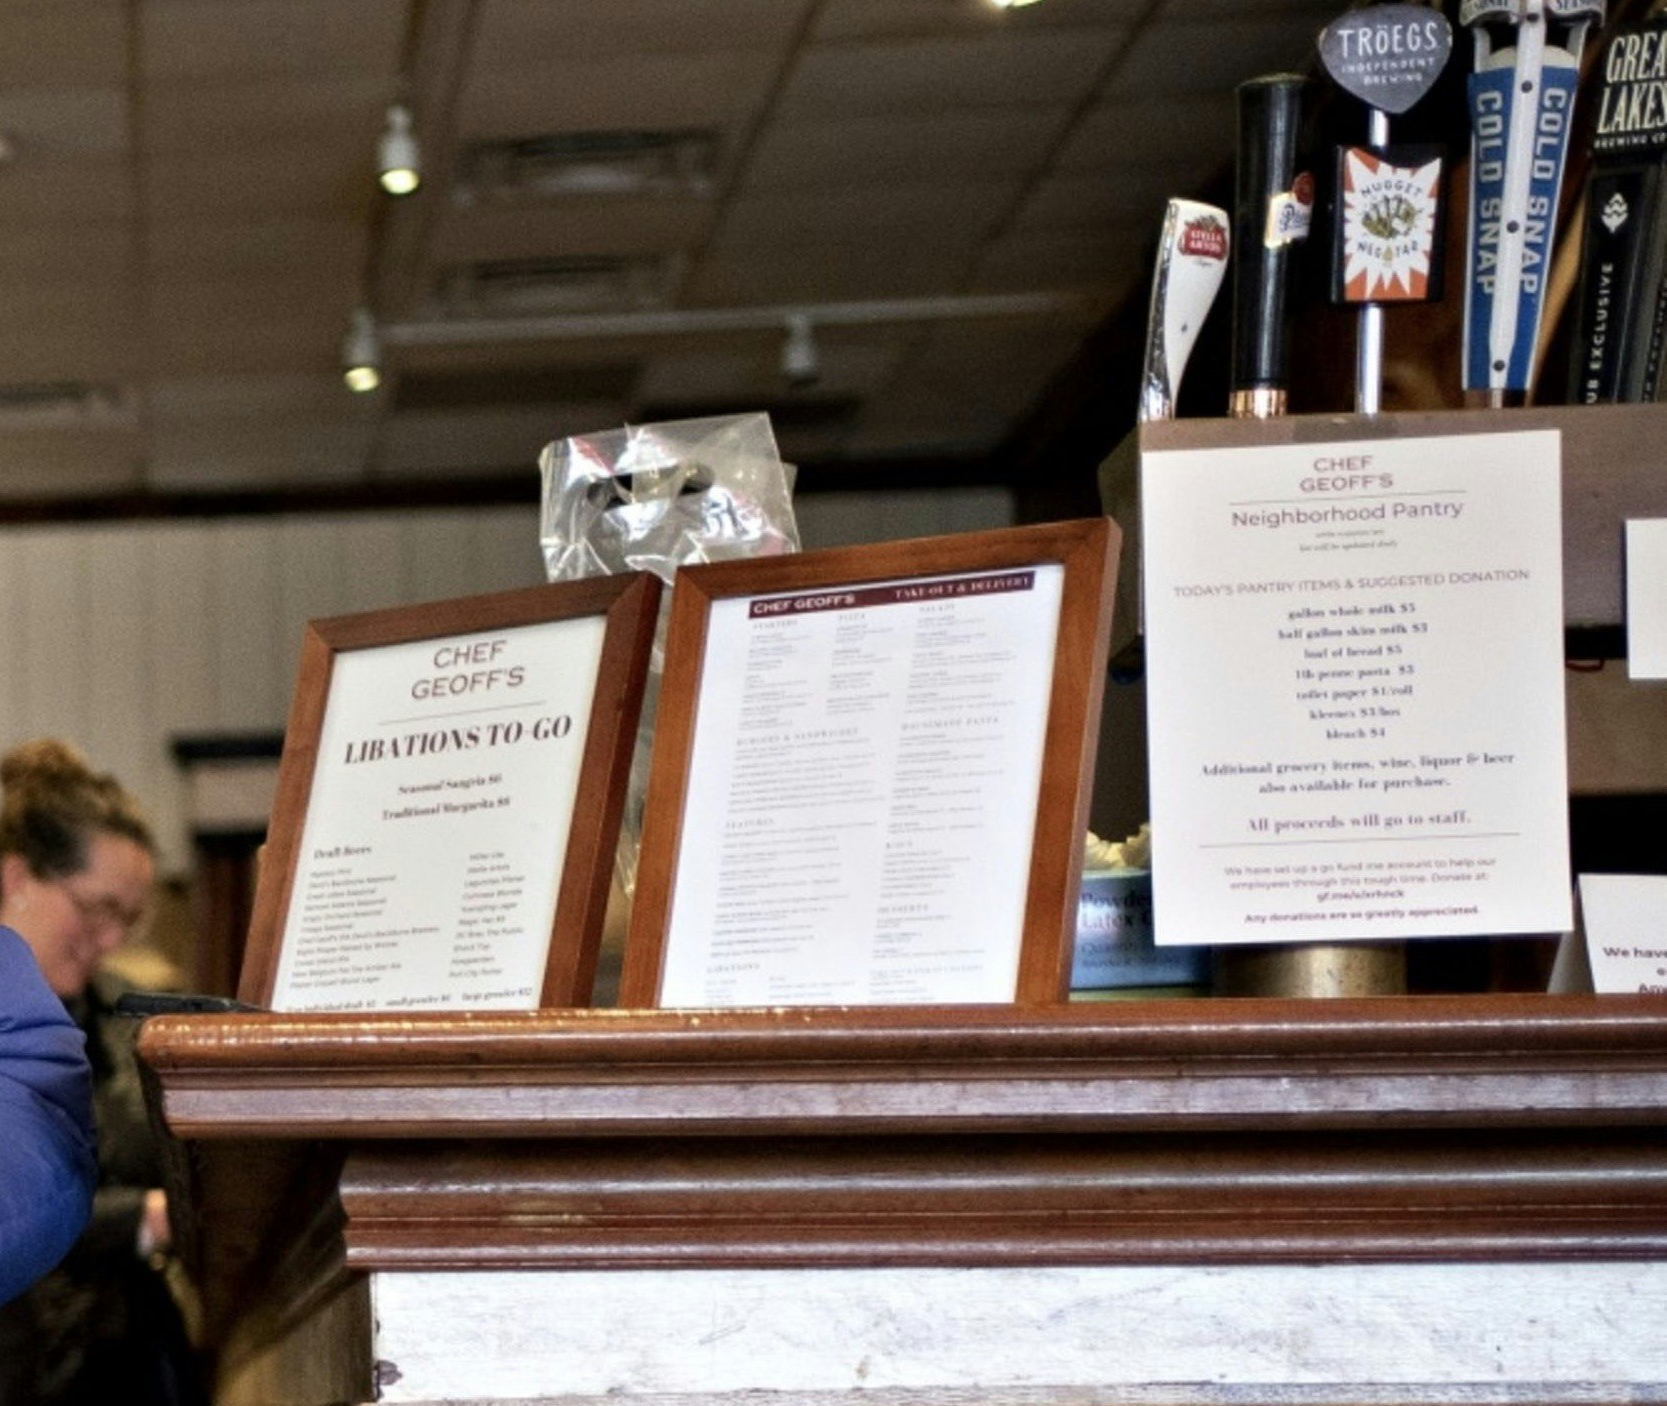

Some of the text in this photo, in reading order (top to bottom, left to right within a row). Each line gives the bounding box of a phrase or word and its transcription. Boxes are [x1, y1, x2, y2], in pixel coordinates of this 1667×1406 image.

[1361, 180, 1423, 197] NUGGET
[1476, 90, 1503, 294] COLD SNAP
[1519, 87, 1567, 293] COLD SNAP
[1589, 263, 1614, 370] EXCLUSIVE
[1313, 455, 1373, 473] CHEF
[1299, 474, 1394, 493] GEOFF'S
[1232, 502, 1464, 529] Neighborhood Pantry
[971, 577, 1029, 591] DELIVERY
[1175, 570, 1530, 596] TODAY'S PANTRY ITEMS & SUGGESTED DONATION
[753, 593, 856, 615] CHEF GEOFF'S
[1288, 608, 1325, 621] gallon
[1329, 605, 1364, 617] whole
[1368, 604, 1396, 615] milk
[1278, 628, 1303, 640] half
[1306, 627, 1343, 640] gallon
[1346, 626, 1376, 636] skim
[1379, 623, 1408, 635] milk
[433, 640, 507, 669] CHEF
[1304, 647, 1328, 659] loaf
[1331, 647, 1343, 658] of
[1346, 645, 1383, 657] bread
[411, 666, 525, 700] GEOFF'S
[1357, 667, 1391, 680] pasta
[1331, 689, 1368, 701] paper
[1326, 728, 1366, 740] bleach
[345, 727, 480, 764] LIBATIONS
[1203, 762, 1273, 776] Additional
[1276, 763, 1327, 775] grocery
[1419, 755, 1463, 770] liquor
[1483, 752, 1515, 765] beer
[446, 776, 486, 790] Sangria
[1259, 782, 1286, 793] also
[1289, 779, 1354, 792] available
[1358, 777, 1378, 789] for
[383, 803, 440, 820] Traditional
[442, 798, 495, 814] Margarita
[1249, 810, 1471, 834] All proceeds will go to staff.
[1224, 867, 1243, 876] We
[1244, 867, 1272, 875] have
[1274, 865, 1291, 874] set
[1292, 865, 1308, 875] up
[1336, 862, 1363, 872] fund
[1386, 860, 1433, 871] account
[1434, 860, 1448, 869] to
[1449, 857, 1476, 868] help
[1476, 858, 1496, 866] our
[1229, 881, 1291, 891] employees
[1292, 877, 1338, 889] through
[1363, 874, 1398, 887] tough
[1431, 872, 1473, 883] Donate
[1245, 914, 1267, 924] Any
[1269, 912, 1327, 922] donations
[1329, 912, 1348, 920] are
[1349, 911, 1363, 919] so
[1364, 909, 1406, 921] greatly
[1603, 946, 1630, 957] We
